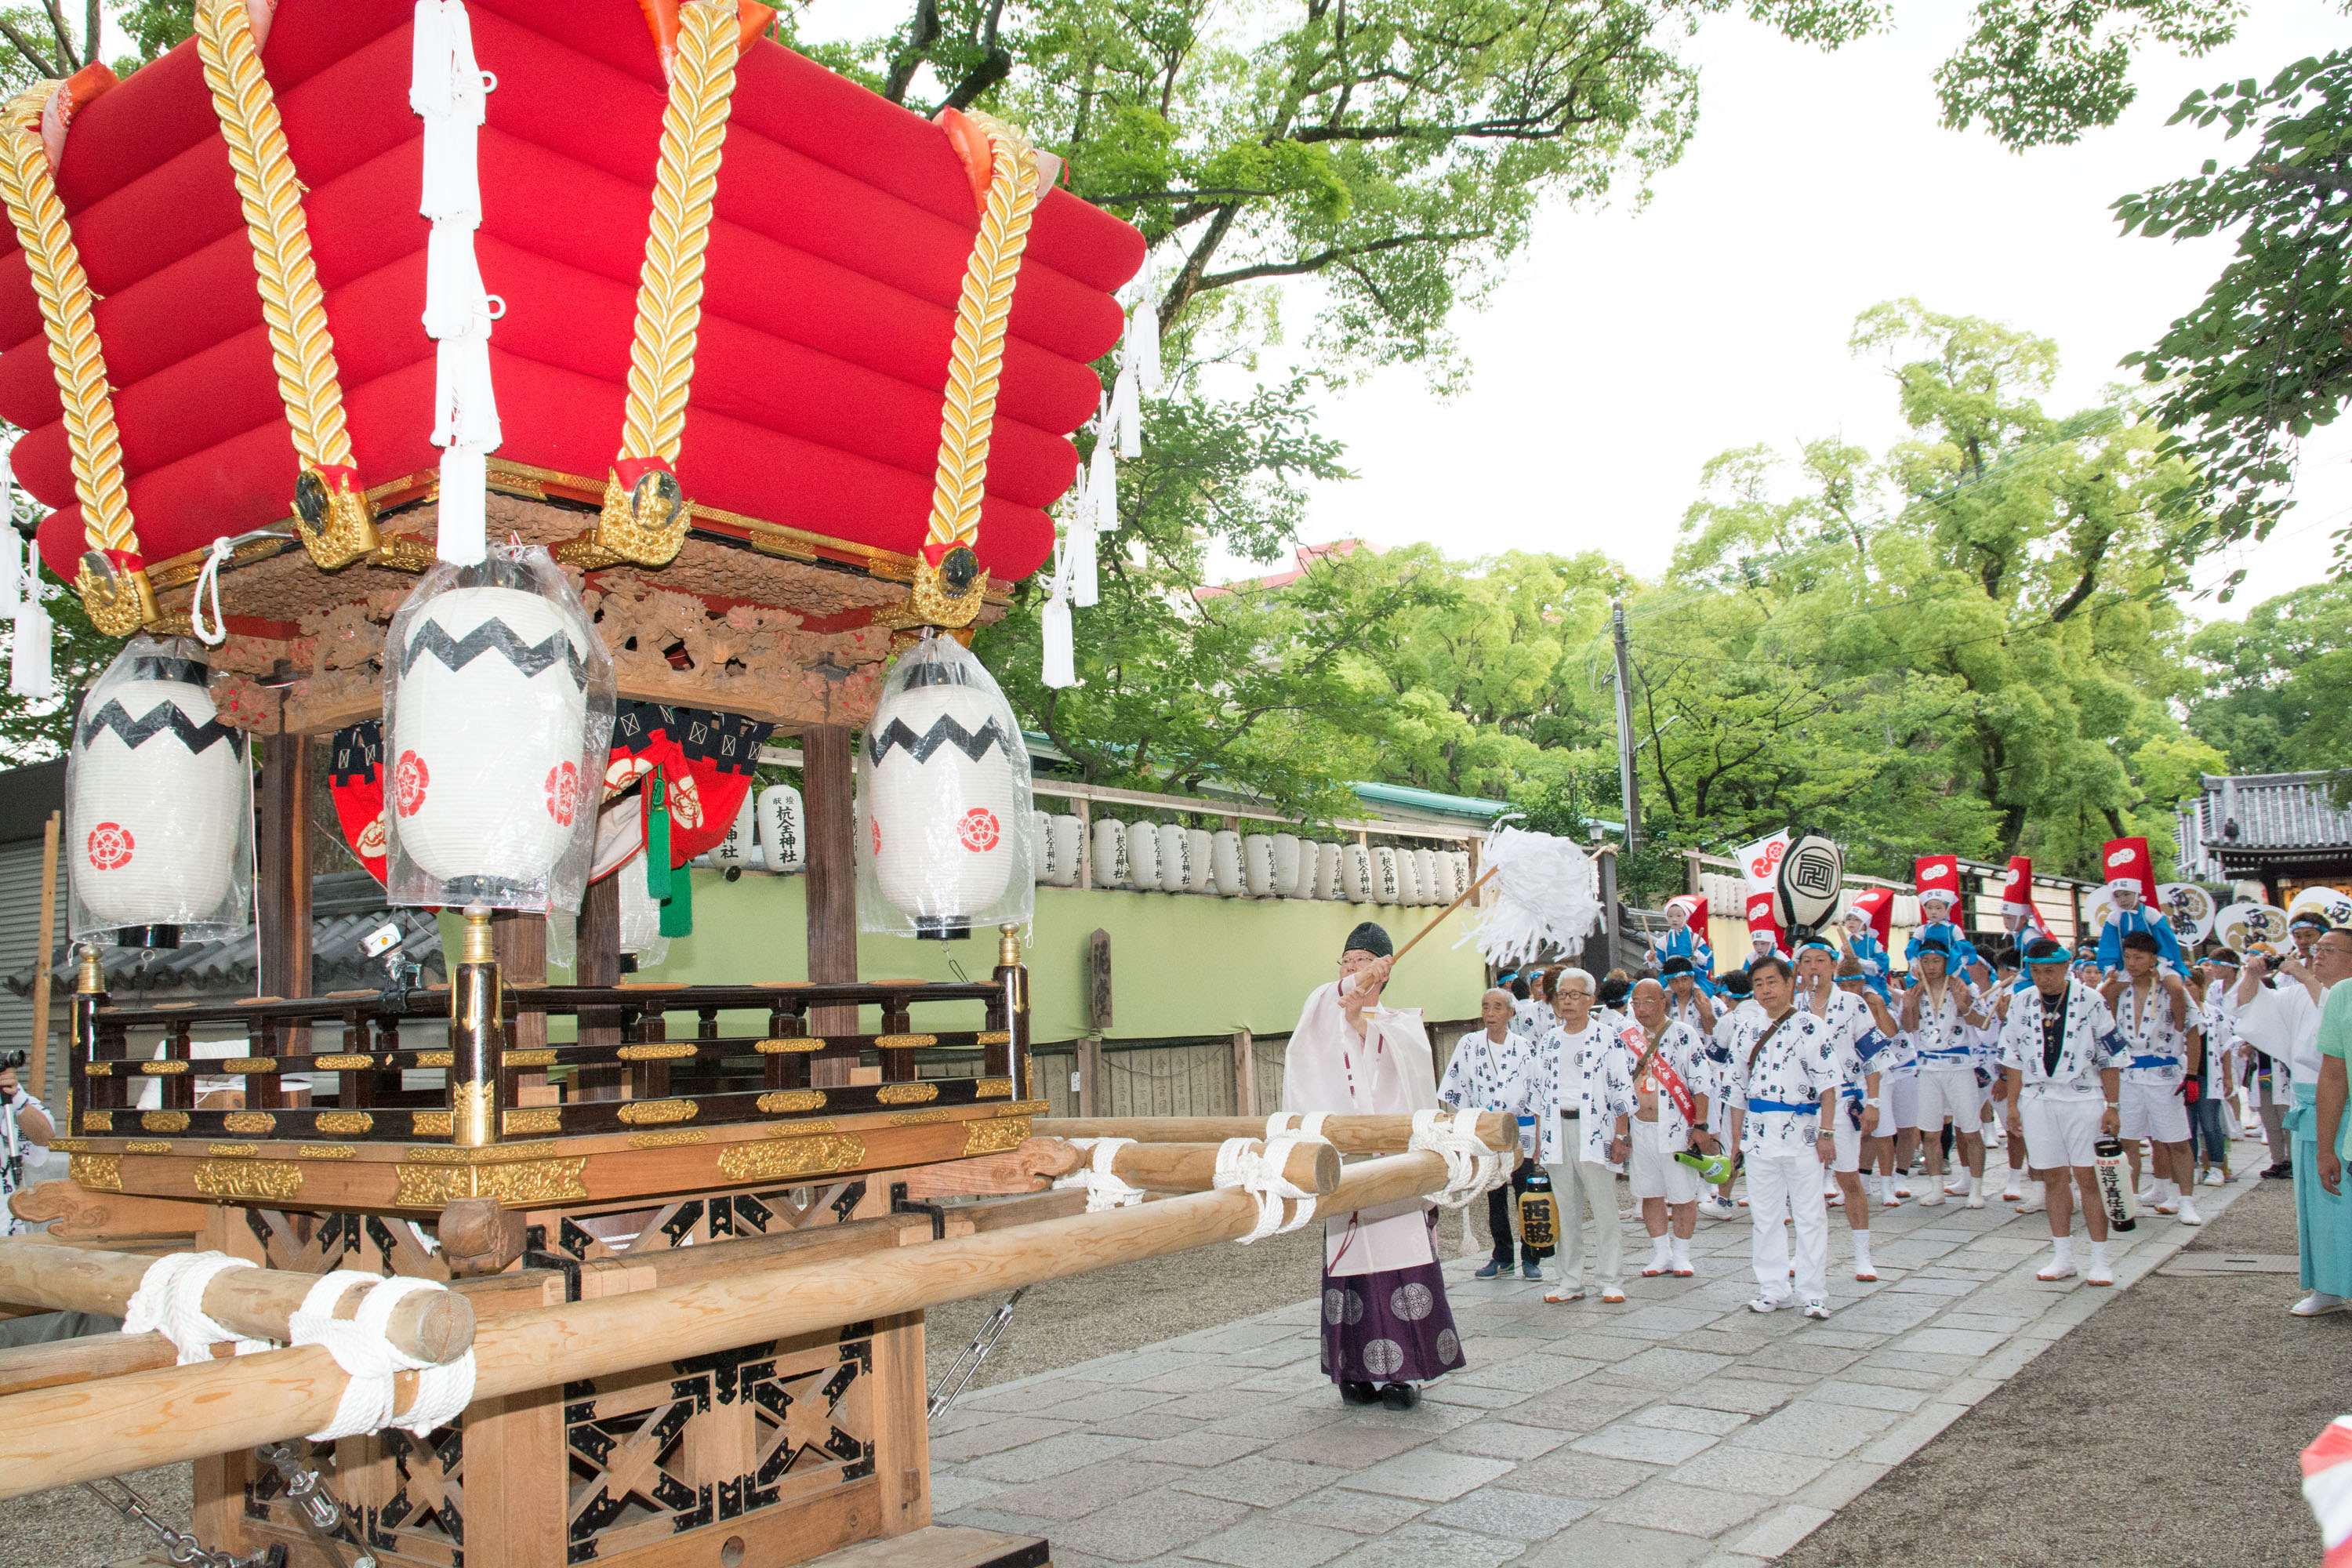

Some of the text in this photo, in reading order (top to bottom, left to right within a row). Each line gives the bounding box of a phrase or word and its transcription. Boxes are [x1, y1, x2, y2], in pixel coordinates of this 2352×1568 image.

[720, 818, 739, 859] 神社
[776, 806, 797, 863] 杭全神社
[1113, 834, 1126, 879] 杭全神社
[1180, 840, 1191, 885] 杭全神社
[1357, 855, 1371, 895] 杭全神社
[1381, 856, 1396, 895] 杭全神社
[1455, 867, 1465, 896] 杭全神
[2100, 1166, 2126, 1221] 巡行責任者
[1522, 1199, 1554, 1243] 西脇
